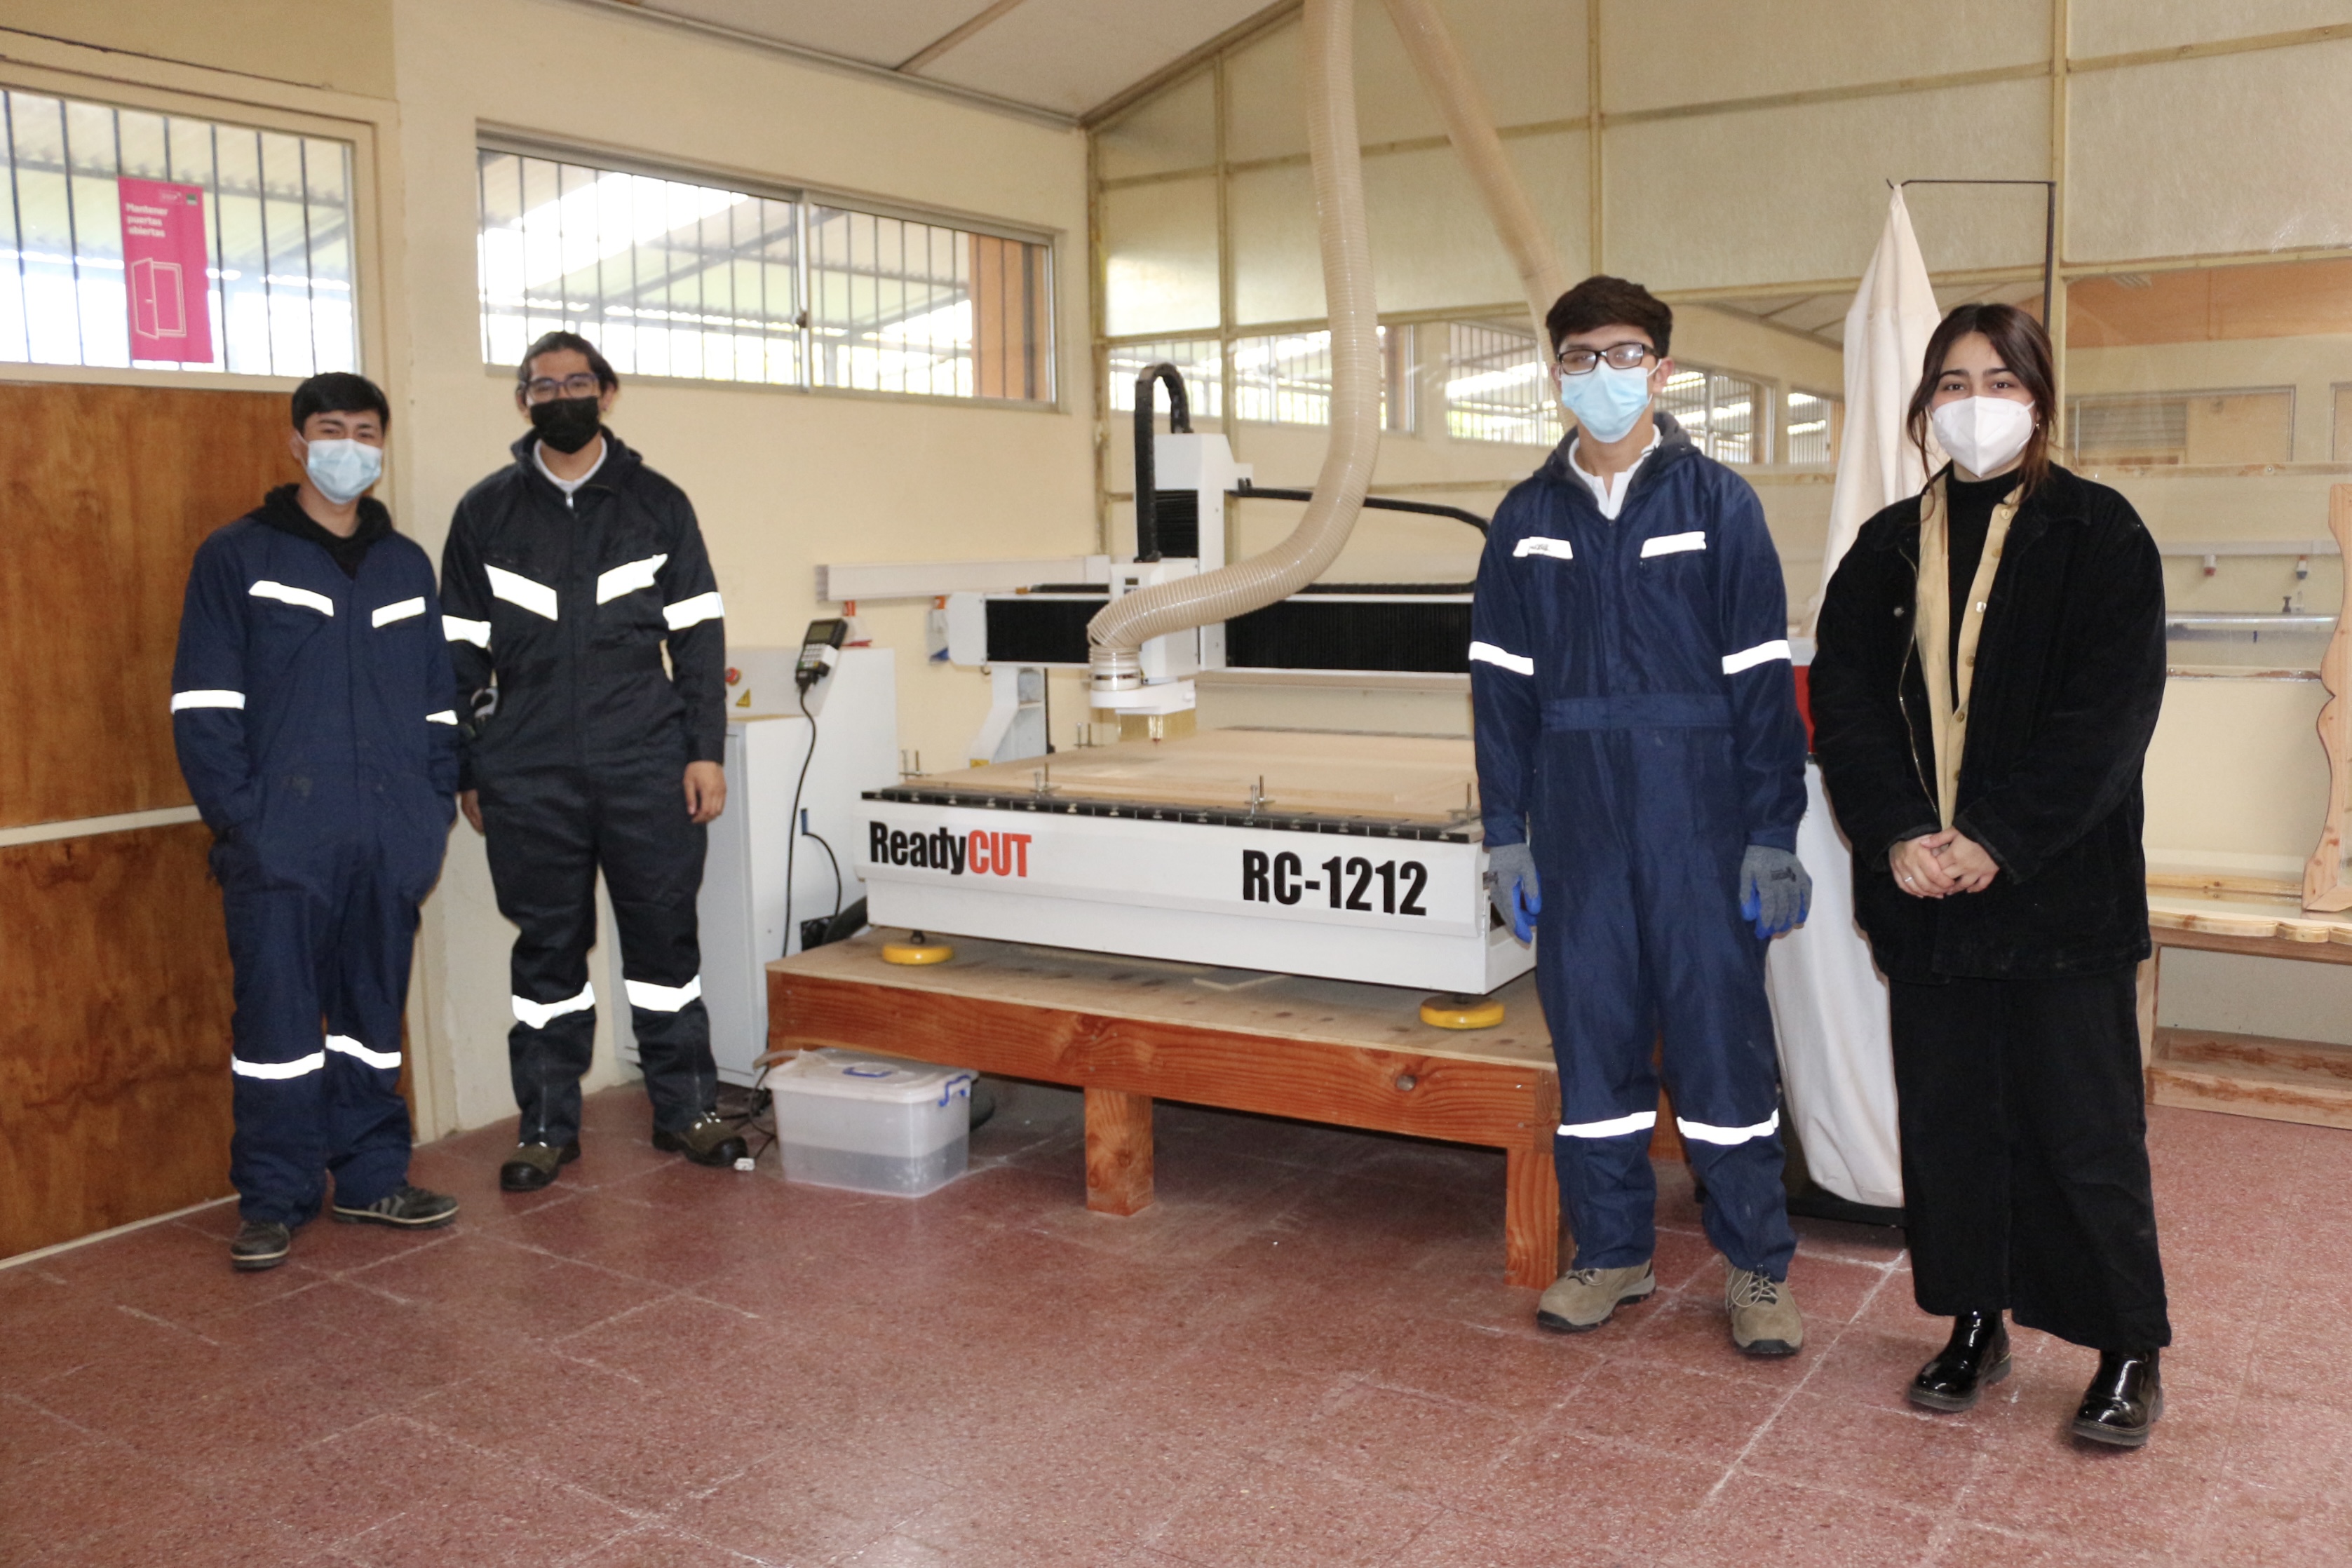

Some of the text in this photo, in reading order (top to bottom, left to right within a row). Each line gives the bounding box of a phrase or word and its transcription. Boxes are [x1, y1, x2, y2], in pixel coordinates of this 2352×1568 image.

[126, 203, 168, 216] Mantener
[127, 215, 163, 227] puertas
[128, 226, 166, 238] abiertas
[870, 820, 1032, 877] ReadyCUT
[1243, 849, 1428, 916] RC-1212
